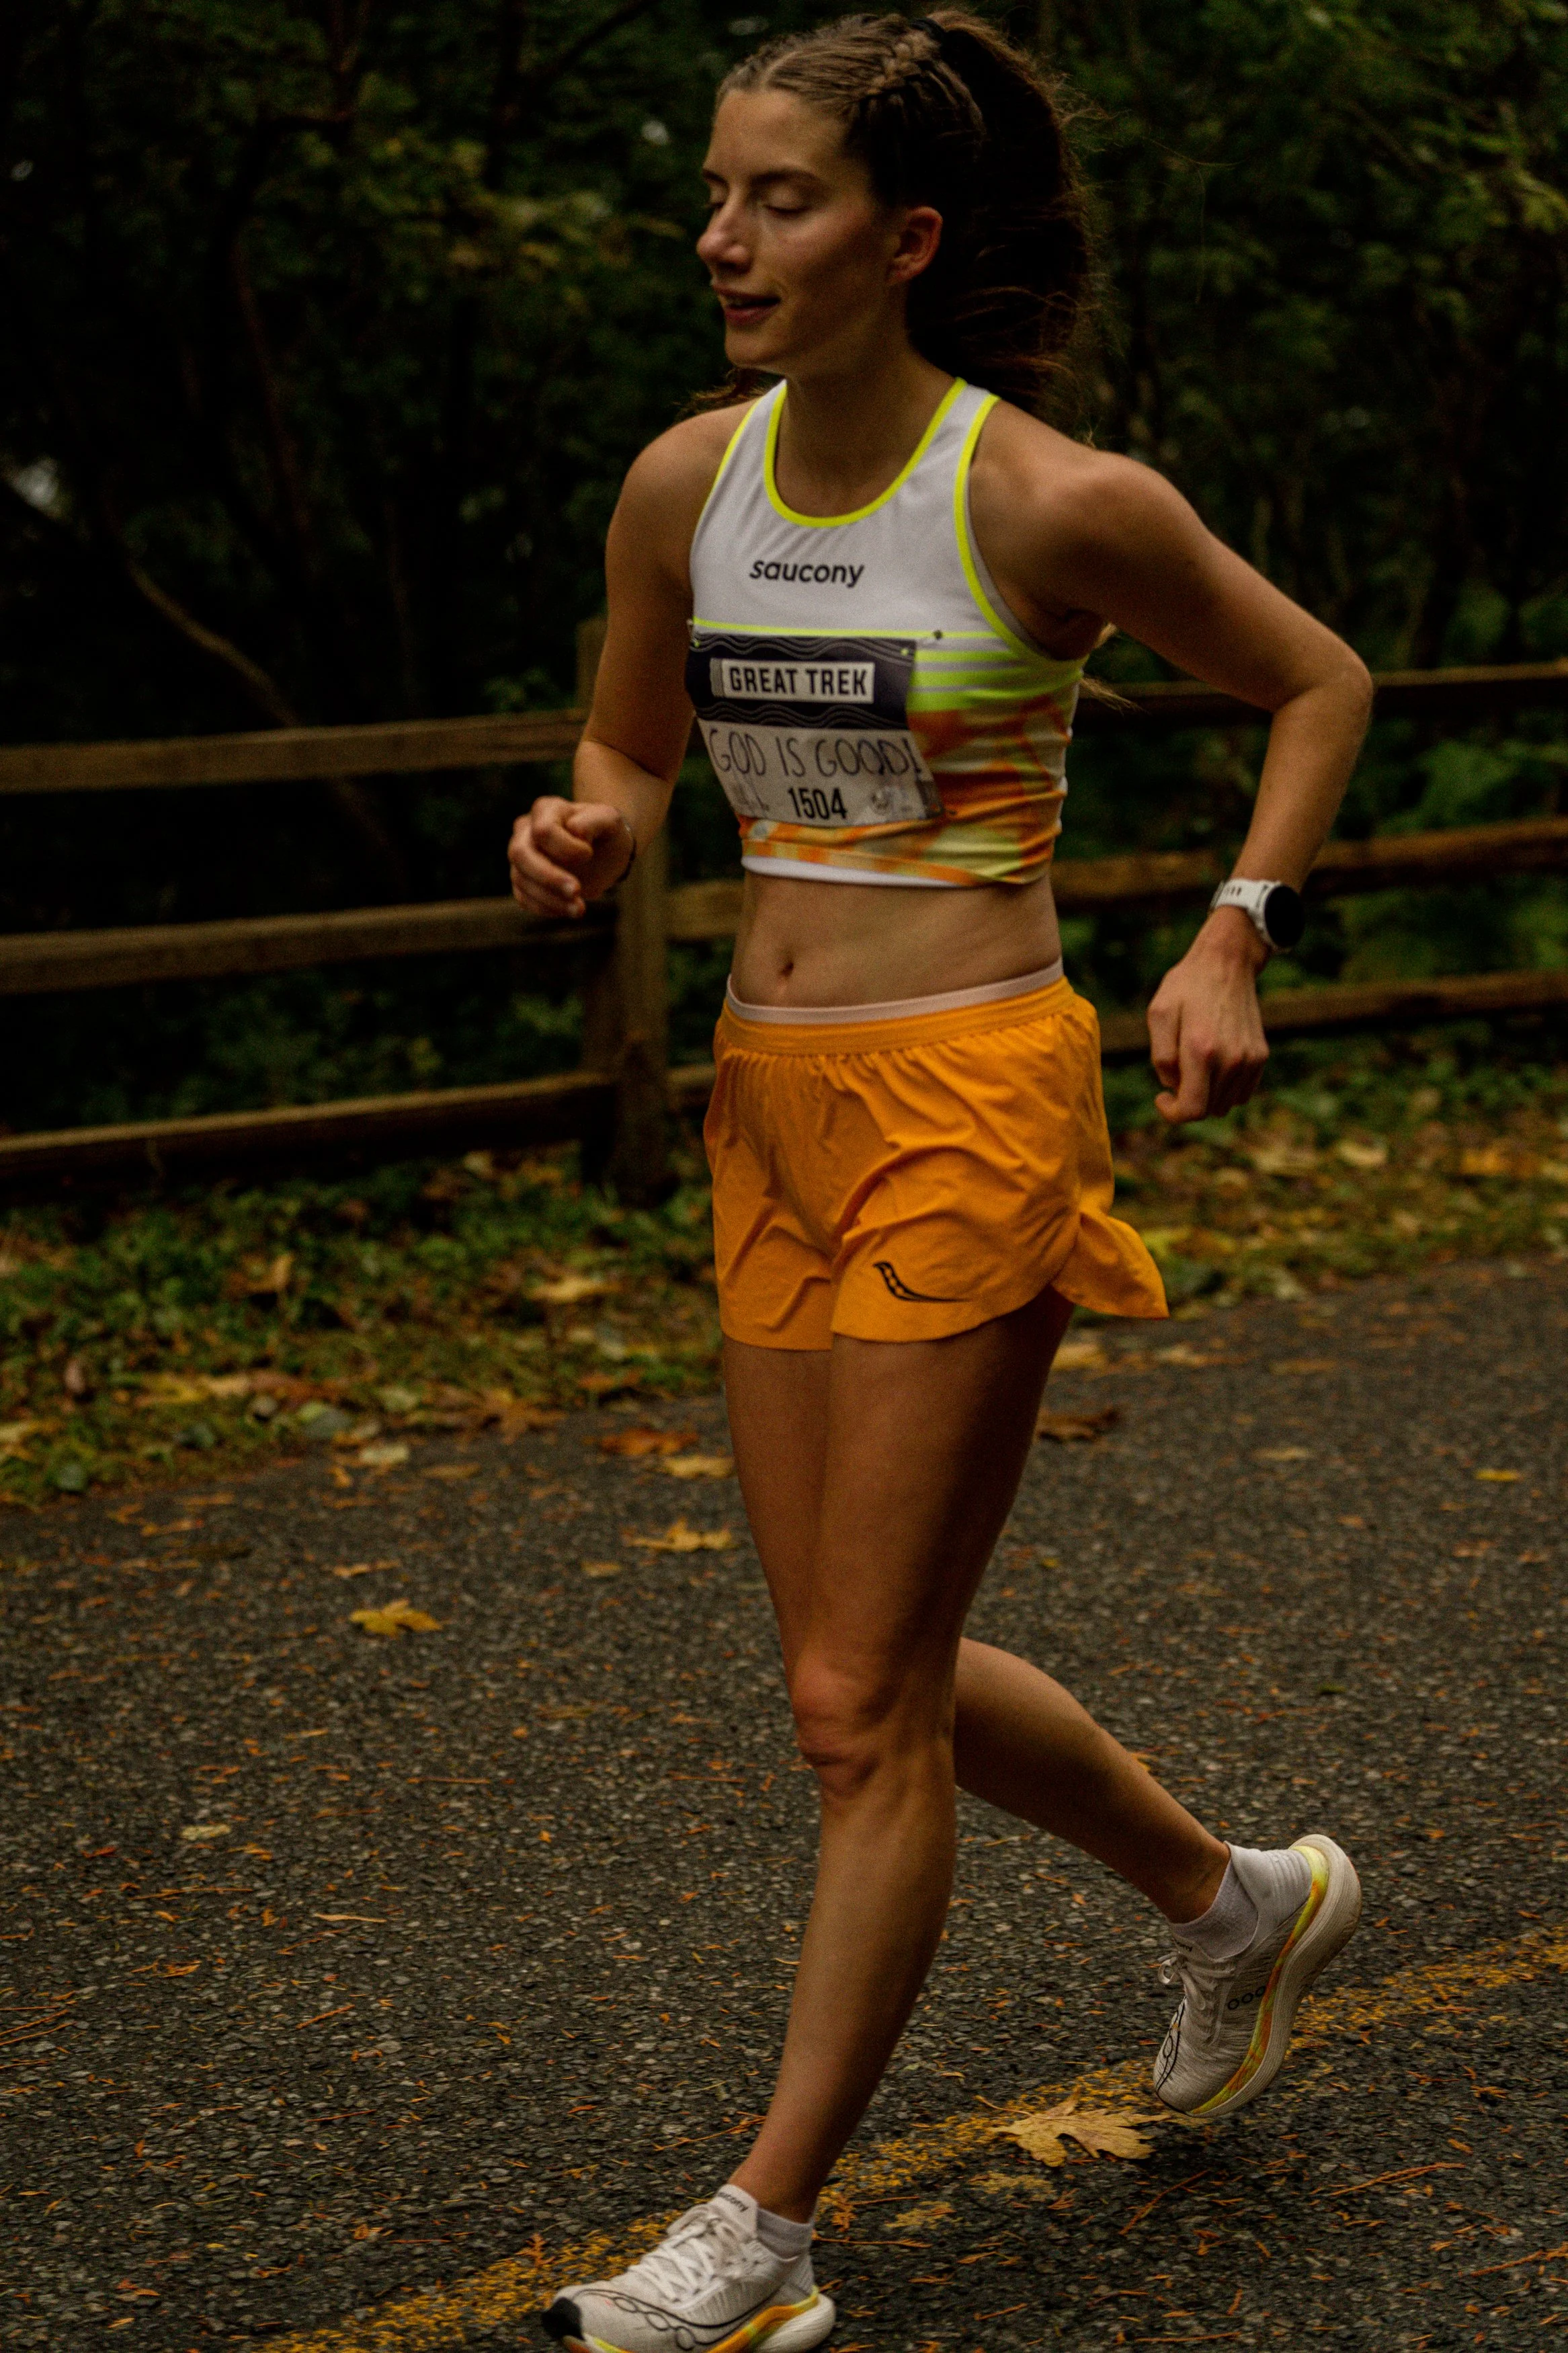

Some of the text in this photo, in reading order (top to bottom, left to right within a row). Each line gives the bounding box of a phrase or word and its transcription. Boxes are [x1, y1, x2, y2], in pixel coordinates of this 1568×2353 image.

[749, 559, 865, 588] saucony
[728, 665, 868, 696] GREAT TREK
[708, 727, 766, 776] GOD
[775, 735, 807, 778] IS
[787, 786, 848, 820] 1504
